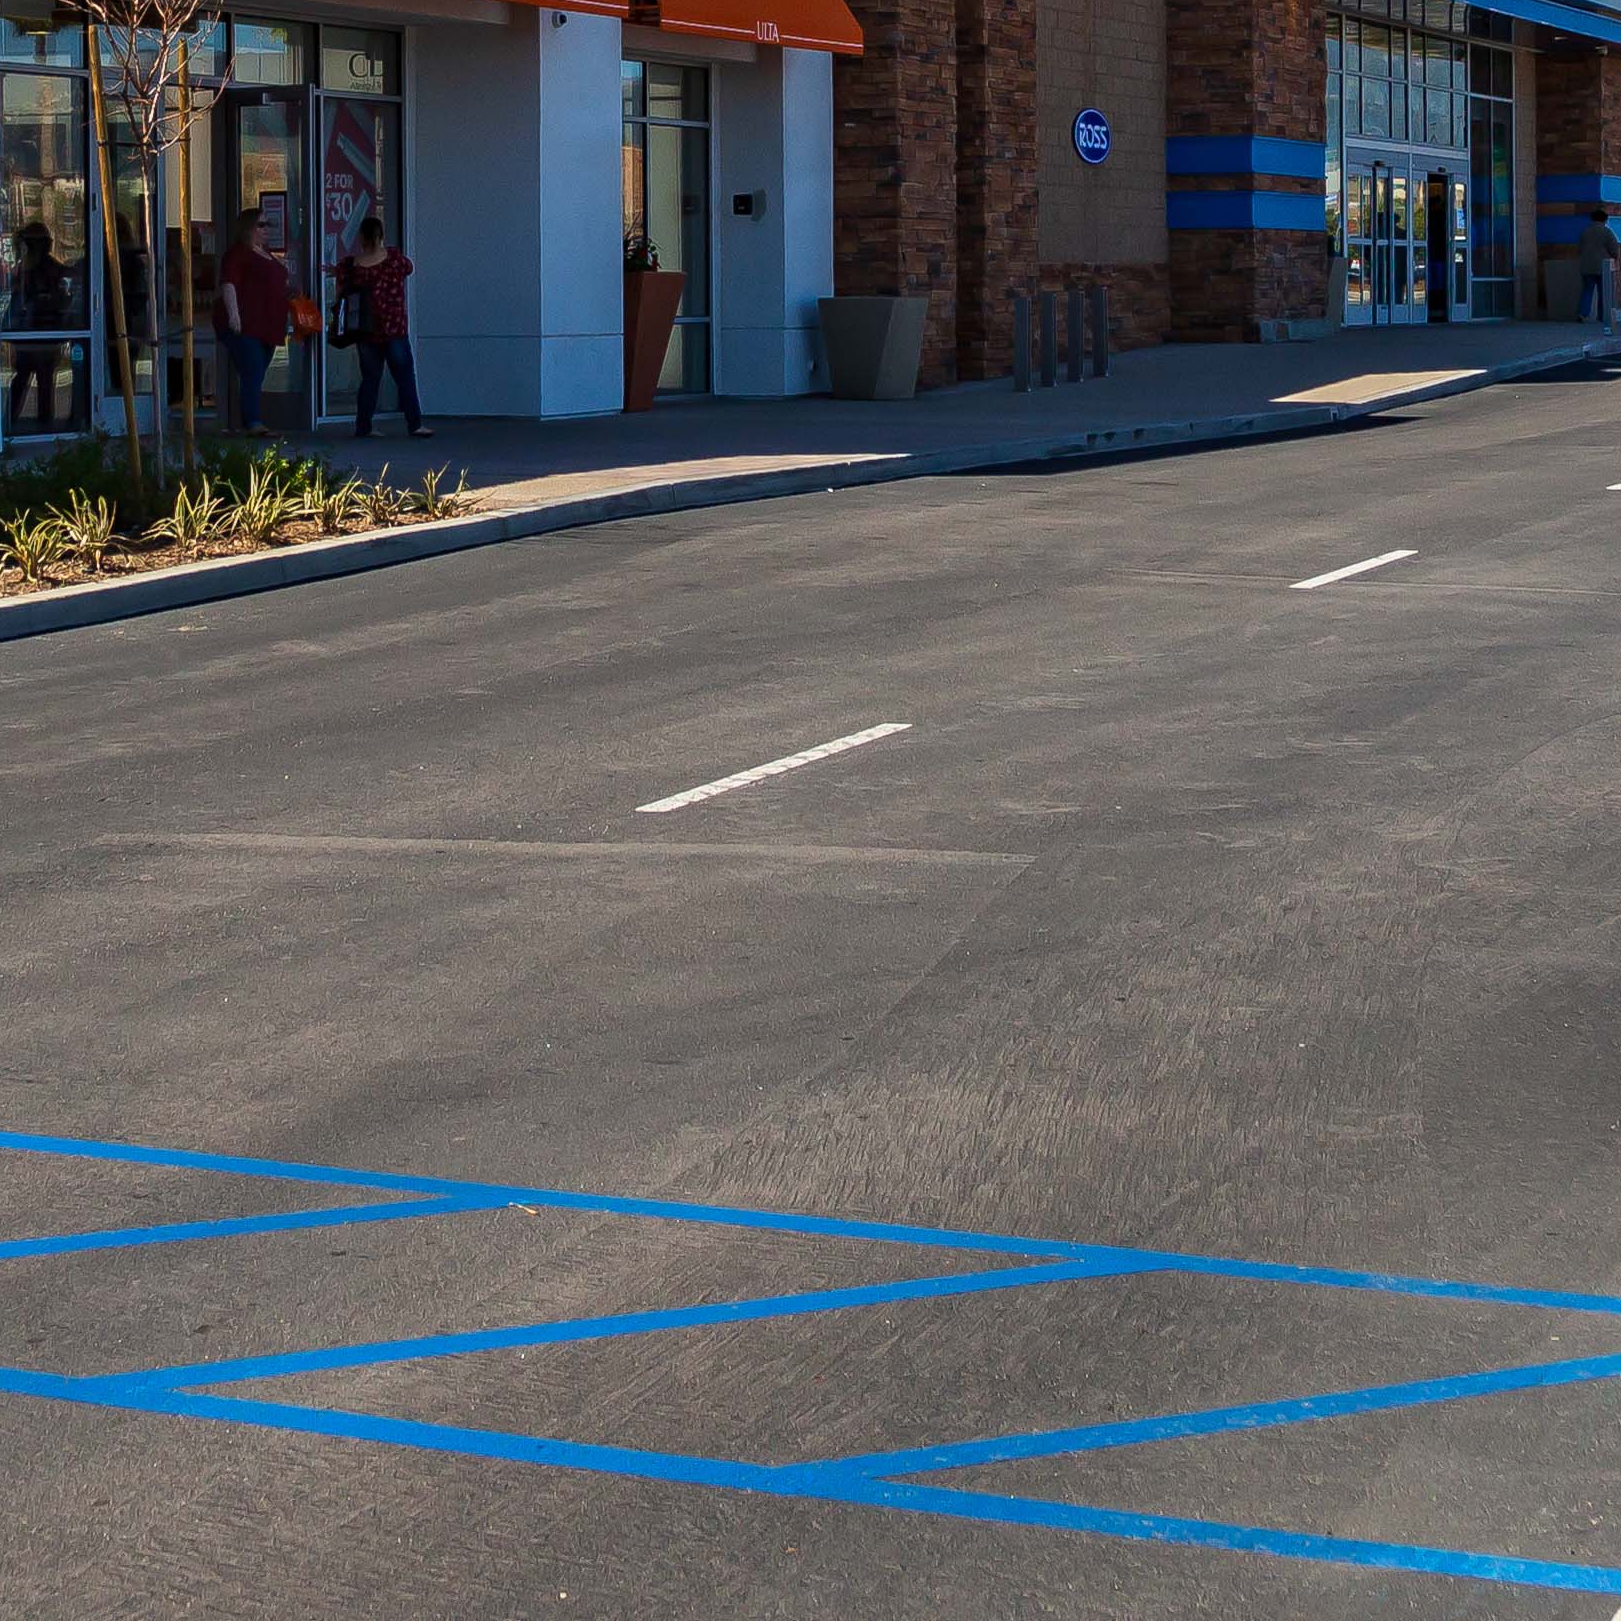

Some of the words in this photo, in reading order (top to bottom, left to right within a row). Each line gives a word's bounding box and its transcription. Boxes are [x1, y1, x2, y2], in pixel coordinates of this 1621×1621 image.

[756, 20, 780, 43] ULTA
[1079, 123, 1108, 149] ROSS
[325, 173, 333, 188] 2
[334, 174, 355, 189] FOR
